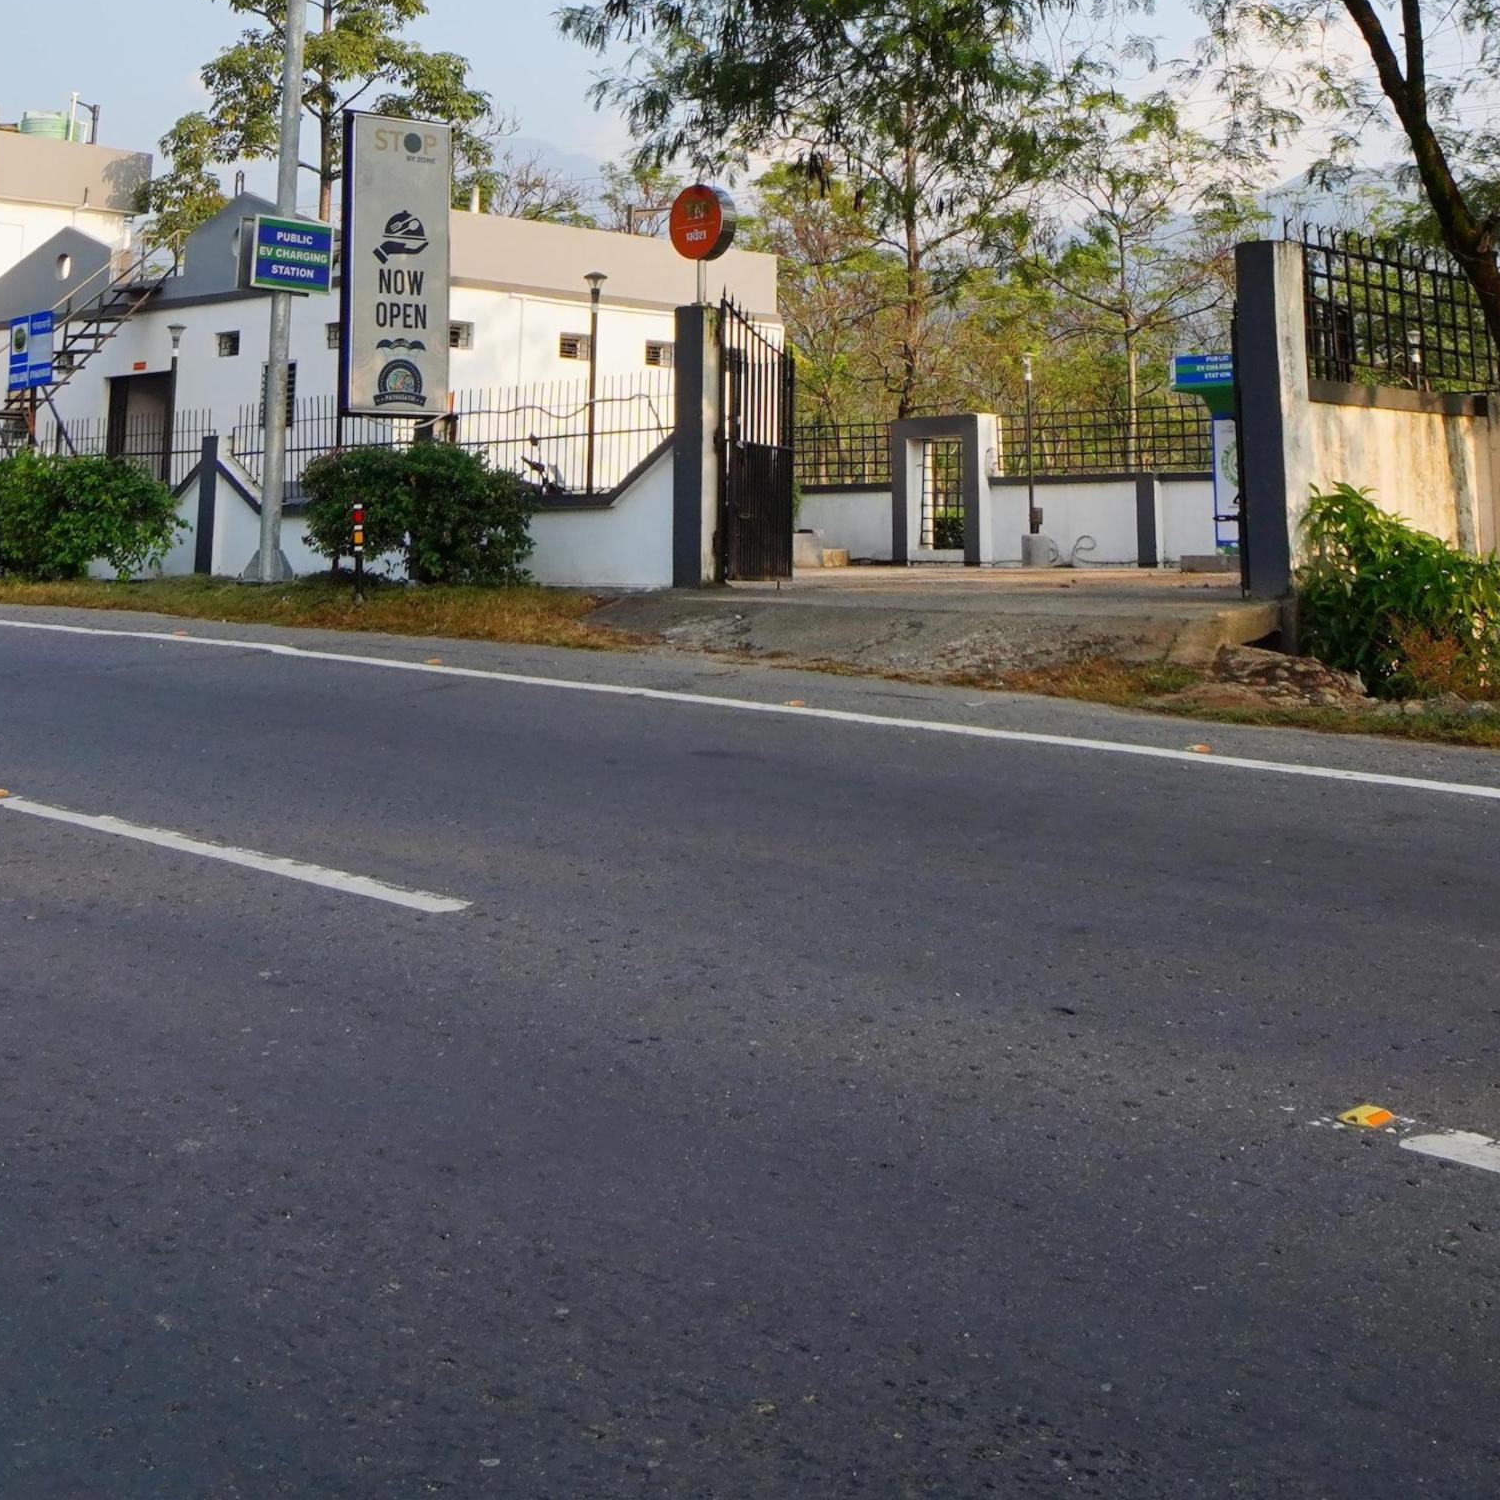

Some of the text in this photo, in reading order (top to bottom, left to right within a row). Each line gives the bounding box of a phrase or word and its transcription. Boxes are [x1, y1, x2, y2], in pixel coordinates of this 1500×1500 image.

[375, 128, 438, 155] STOP
[276, 231, 313, 245] PUBLIC
[260, 246, 327, 263] EV CHARGING
[271, 264, 314, 278] STATION
[379, 268, 424, 296] NOW
[376, 301, 426, 329] OPEN
